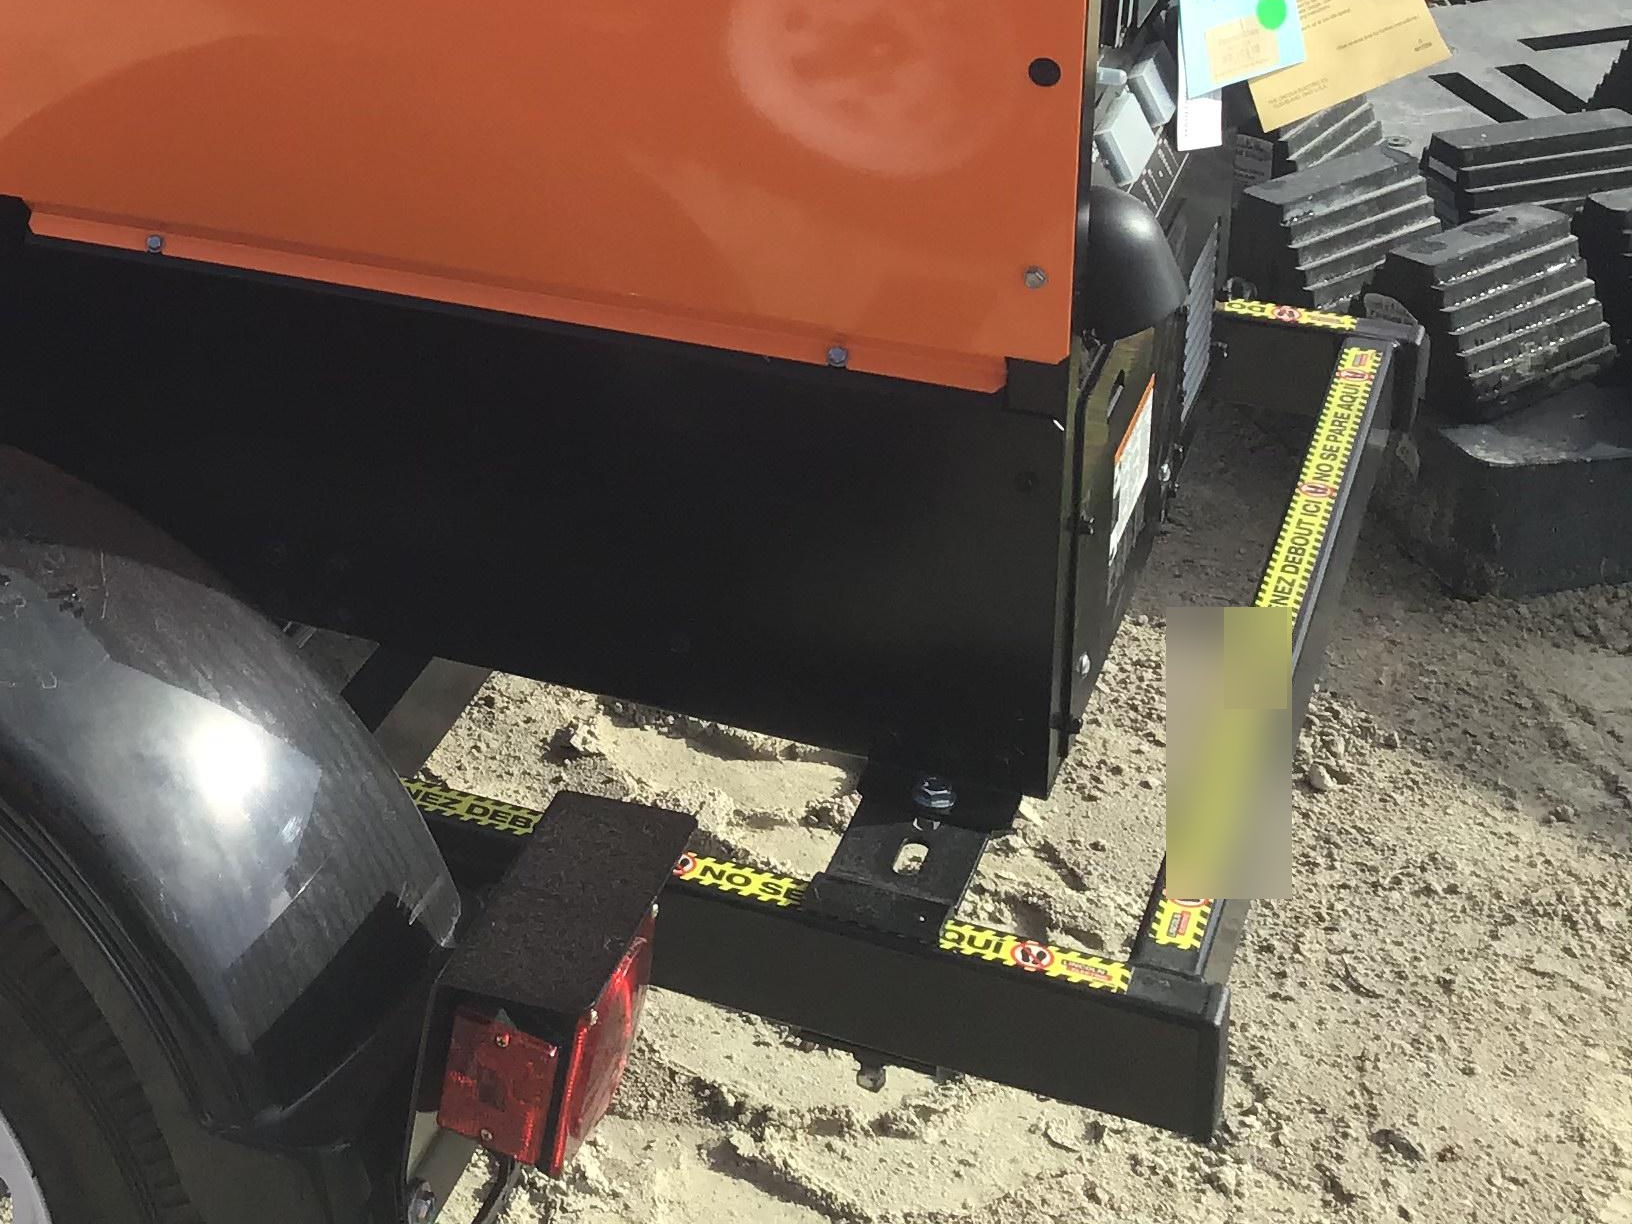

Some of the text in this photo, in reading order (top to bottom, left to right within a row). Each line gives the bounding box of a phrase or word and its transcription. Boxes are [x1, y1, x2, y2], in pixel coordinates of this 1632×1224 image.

[1325, 414, 1352, 446] PARE
[1321, 443, 1341, 462] SE
[1312, 462, 1334, 483] NO
[1302, 499, 1323, 518] ICI
[1280, 517, 1311, 575] DEBOUT
[1268, 576, 1296, 608] NEZ
[699, 865, 752, 887] NO
[758, 880, 806, 903] SE
